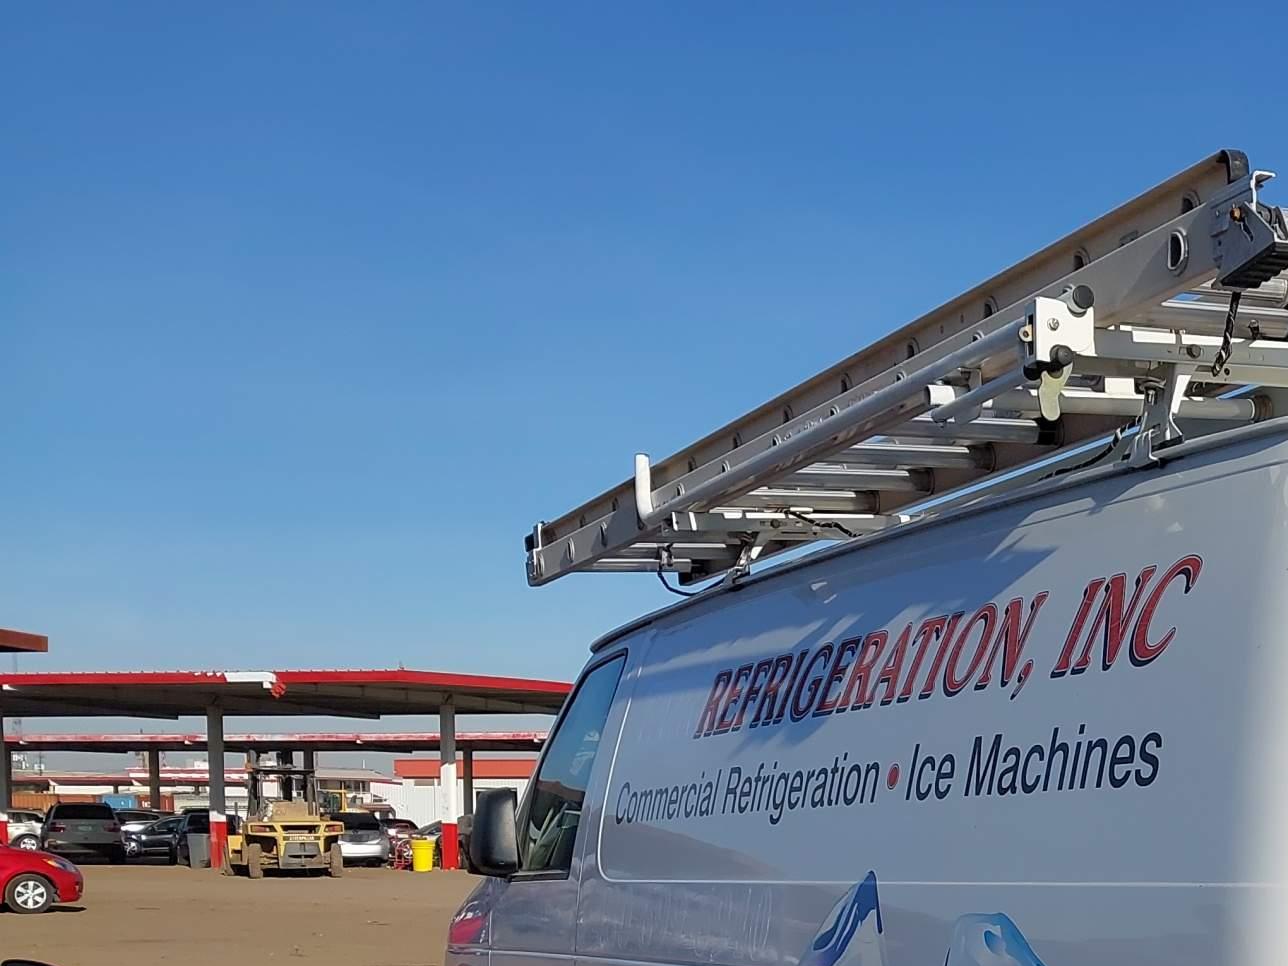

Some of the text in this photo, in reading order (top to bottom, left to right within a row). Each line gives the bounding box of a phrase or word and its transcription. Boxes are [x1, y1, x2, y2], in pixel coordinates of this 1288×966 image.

[693, 553, 1204, 740] REFRIGERATION, INC
[615, 723, 1163, 825] Commercial Refrigeration Ice Machines
